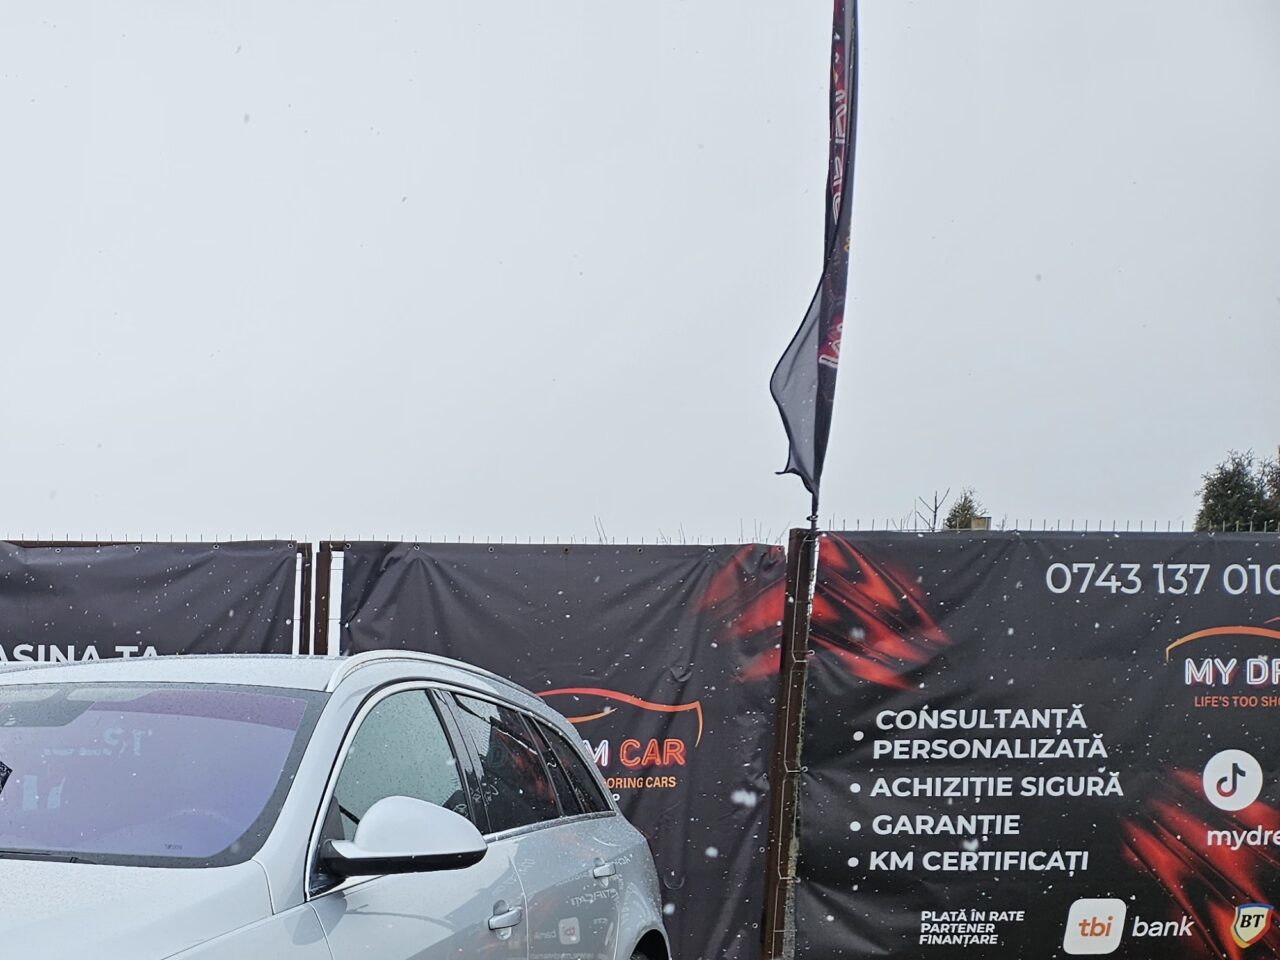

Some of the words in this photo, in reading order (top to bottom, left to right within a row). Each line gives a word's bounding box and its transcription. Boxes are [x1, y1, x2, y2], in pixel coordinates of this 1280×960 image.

[1046, 563, 1141, 595] 0743
[1153, 563, 1211, 595] 137
[1185, 657, 1237, 686] MY
[1194, 695, 1229, 708] LIFE'S
[1232, 695, 1258, 708] TOO
[876, 704, 1087, 736] CONSULTANȚĂ
[620, 738, 686, 767] CAR
[872, 733, 1108, 760] PERSONALIZATĂ
[603, 776, 644, 789] ORING
[645, 776, 677, 788] CARS
[870, 777, 1013, 804] ACHIZIȚIE
[1020, 771, 1124, 798] SIGURĂ
[872, 814, 1021, 842] GARANȚIE
[870, 851, 914, 871] KM
[922, 850, 1089, 877] CERTIFICAȚI
[920, 923, 996, 934] PARTENER
[921, 908, 967, 922] PLATĂ
[970, 908, 986, 922] ÎN
[989, 910, 1025, 922] RATE
[1078, 915, 1114, 937] tbi
[1132, 915, 1195, 937] bank
[1240, 914, 1264, 928] BT
[919, 934, 999, 947] FINANȚARE
